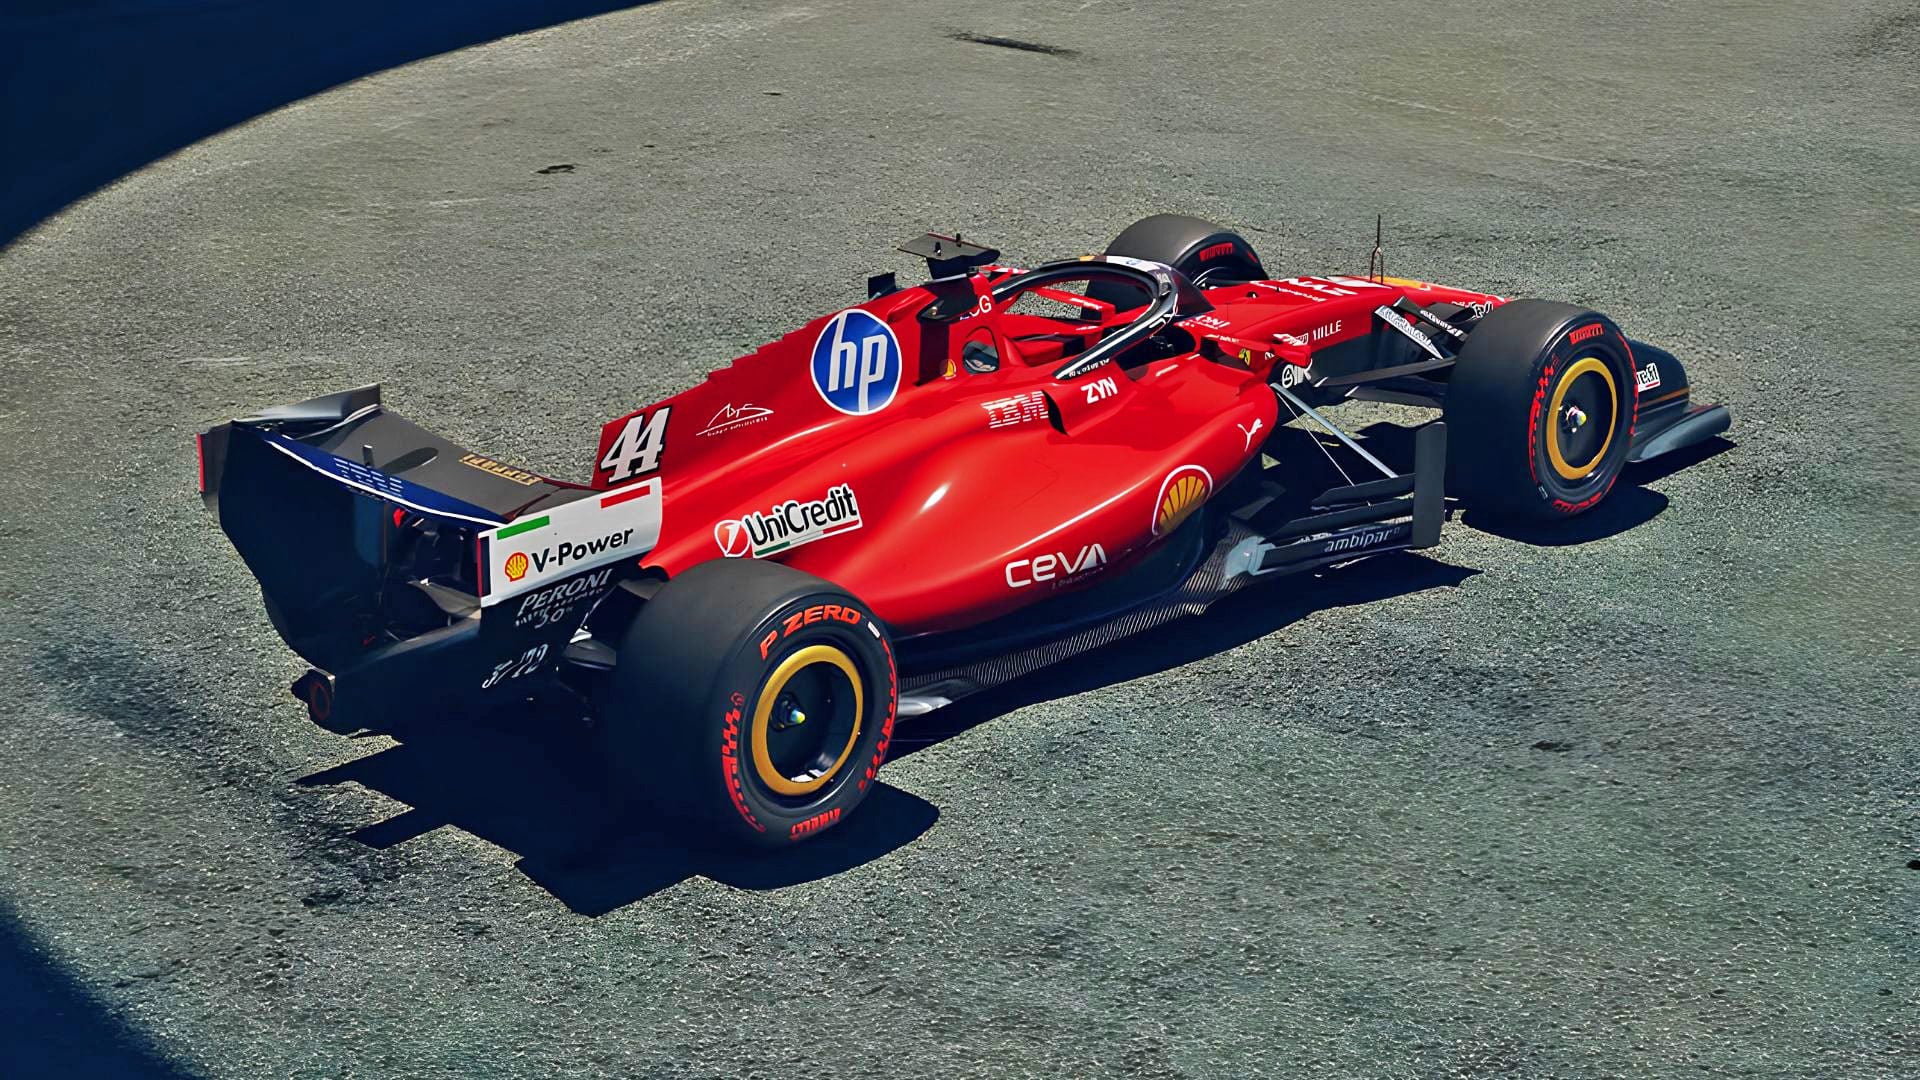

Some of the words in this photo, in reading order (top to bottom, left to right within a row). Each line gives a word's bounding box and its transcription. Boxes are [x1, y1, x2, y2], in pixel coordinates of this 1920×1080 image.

[827, 311, 888, 414] hp
[980, 390, 1049, 429] IBM
[1080, 376, 1118, 404] ZYN
[601, 406, 672, 484] 44
[744, 485, 858, 546] UniCredit
[531, 528, 634, 572] V-Power
[1324, 529, 1393, 553] ambipar
[517, 568, 613, 617] PERONI
[760, 630, 778, 660] P
